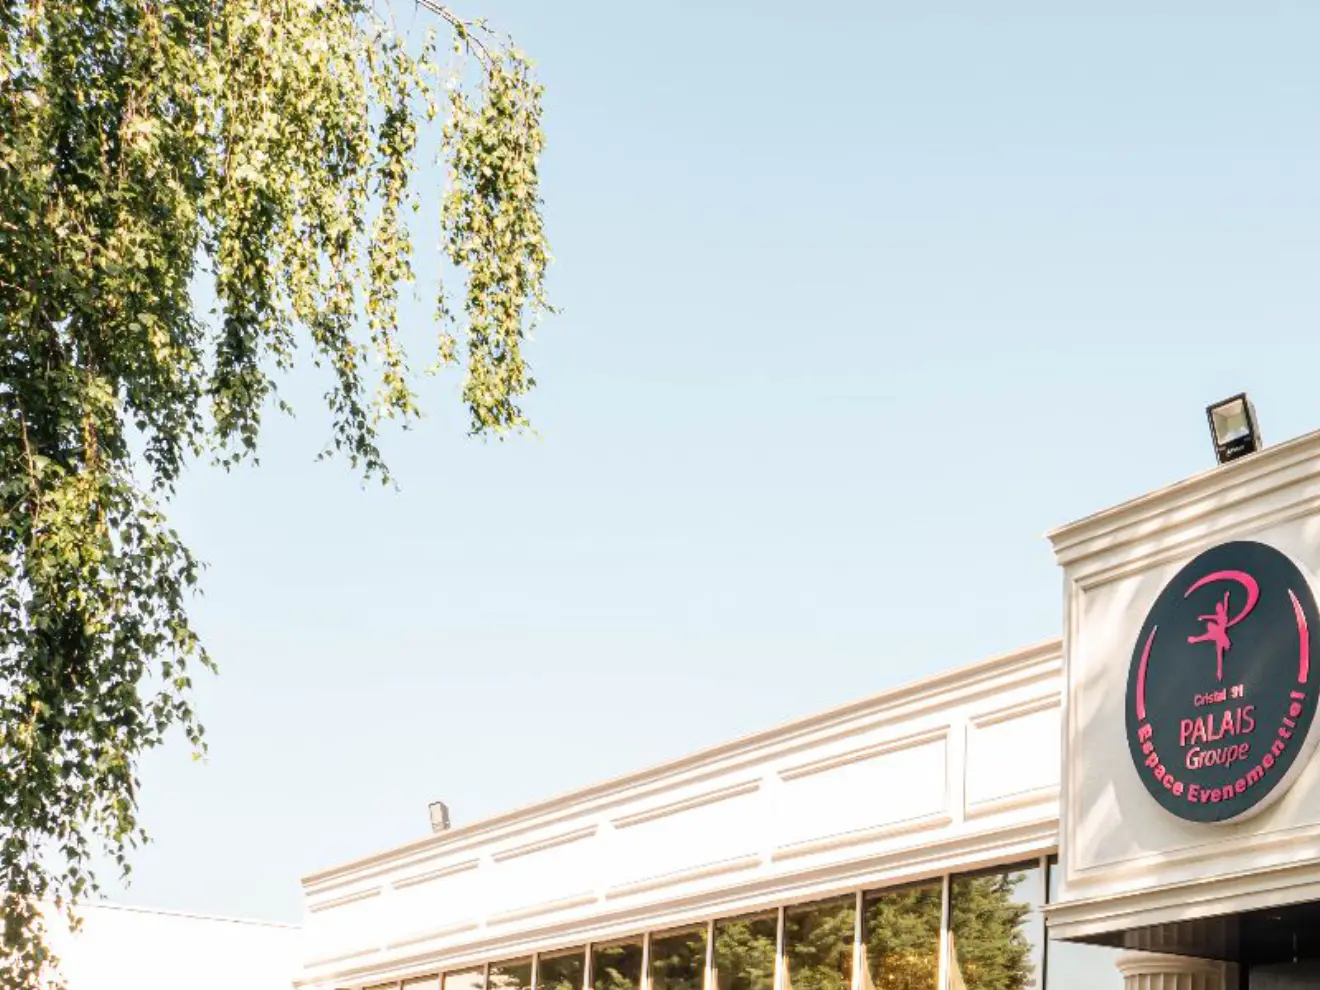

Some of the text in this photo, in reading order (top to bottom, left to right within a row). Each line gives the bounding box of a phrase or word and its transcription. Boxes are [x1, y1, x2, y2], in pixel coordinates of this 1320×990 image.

[1180, 705, 1255, 747] PALAIS
[1138, 723, 1184, 796] Espace
[1186, 743, 1250, 769] Groupe
